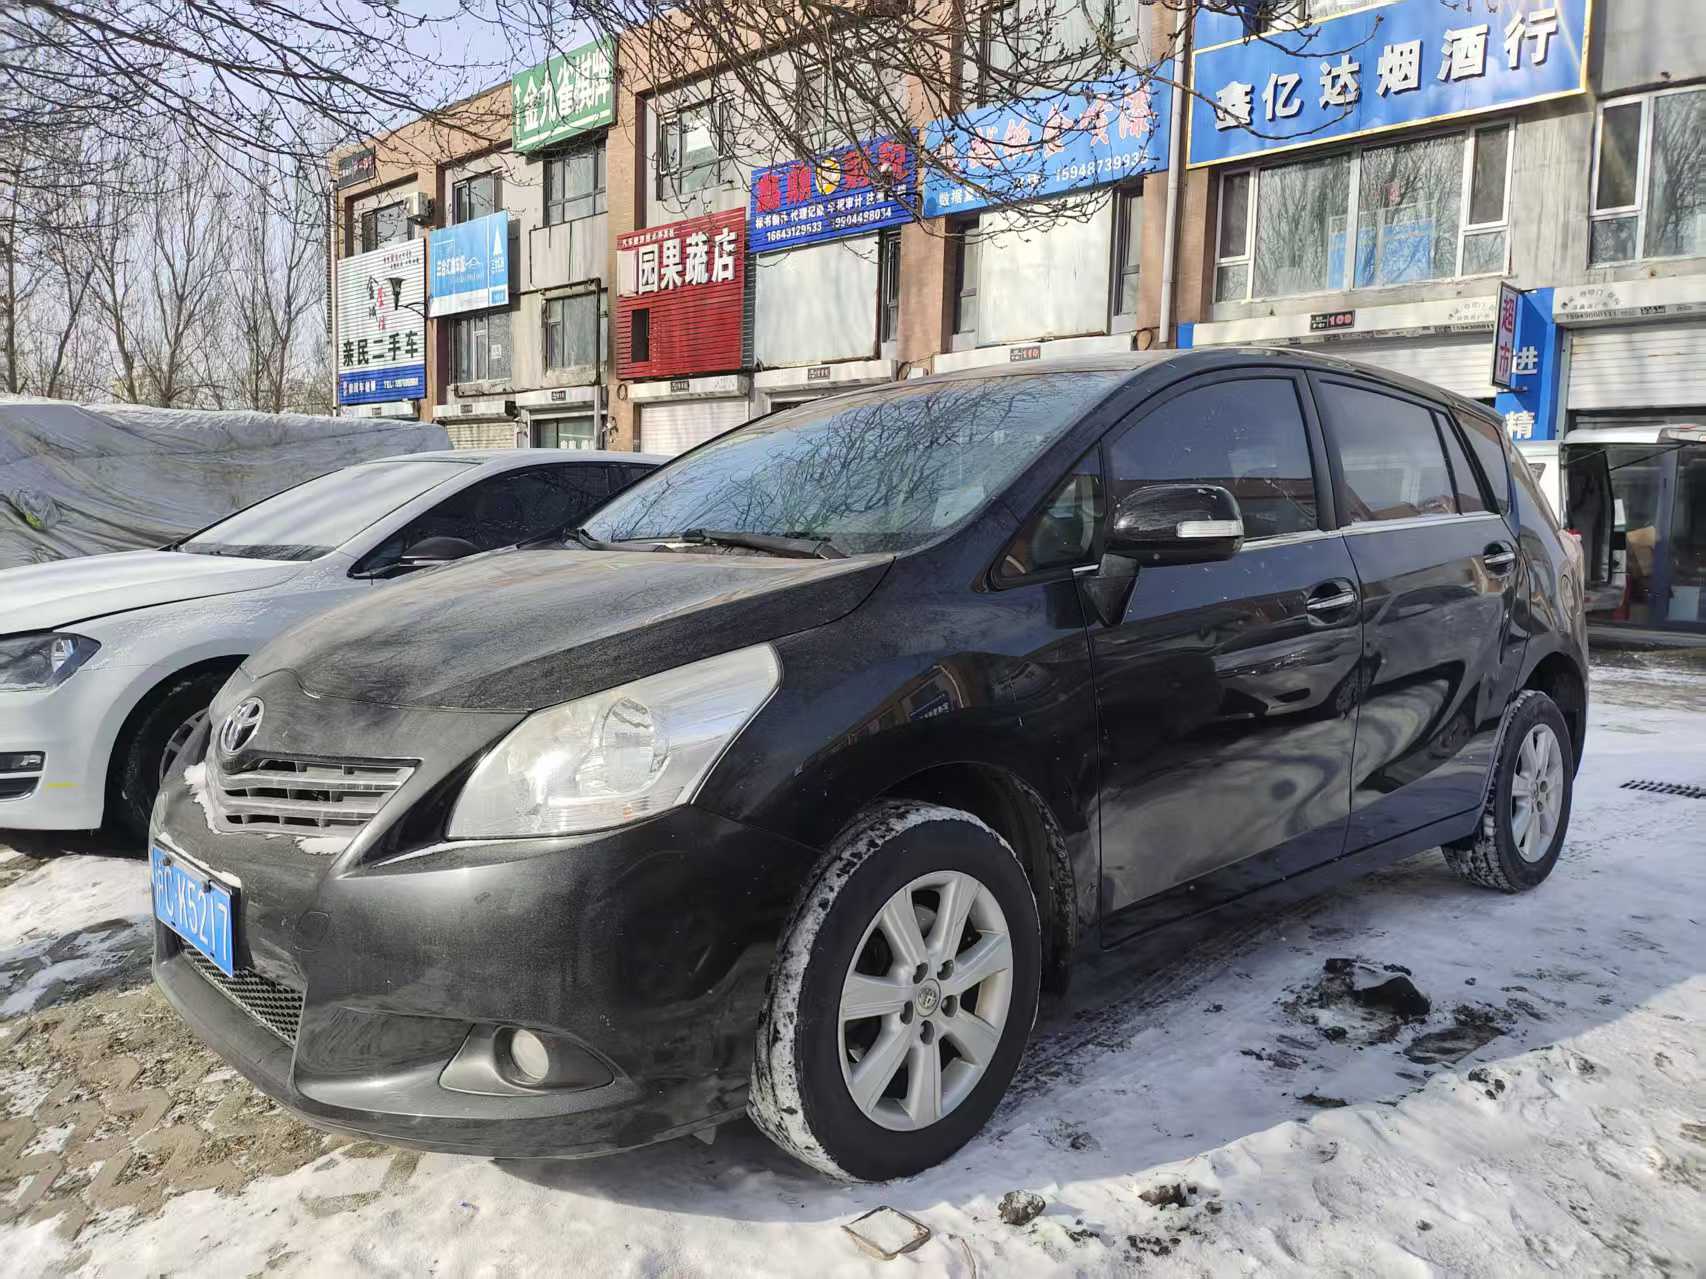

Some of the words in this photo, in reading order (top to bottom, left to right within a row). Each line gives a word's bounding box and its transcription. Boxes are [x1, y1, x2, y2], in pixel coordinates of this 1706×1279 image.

[638, 227, 738, 295] 园果蔬店
[343, 329, 419, 367] 亲民二手车
[1499, 296, 1515, 377] 超市
